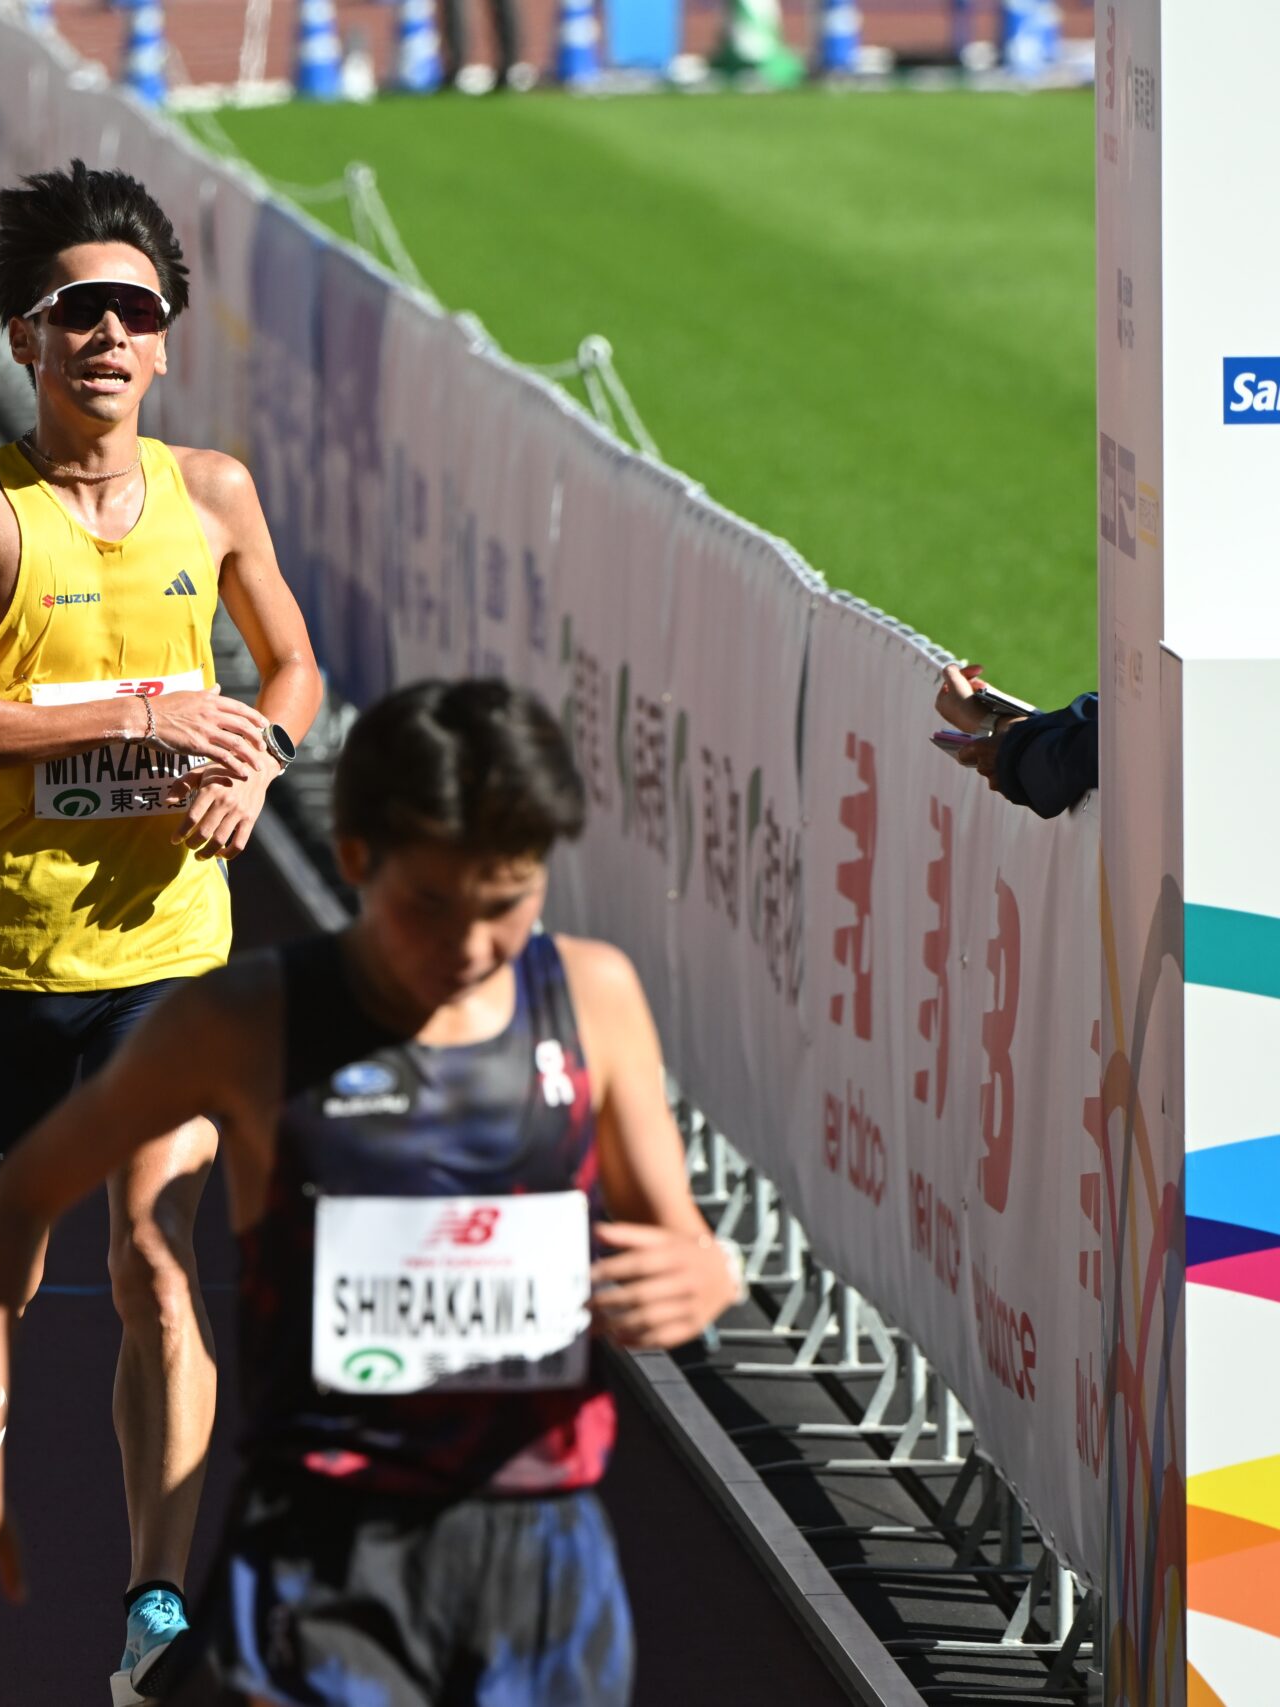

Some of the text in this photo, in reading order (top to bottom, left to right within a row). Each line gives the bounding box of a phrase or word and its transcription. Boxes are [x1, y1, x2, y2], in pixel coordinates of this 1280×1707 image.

[1230, 372, 1280, 412] Sa
[56, 593, 100, 605] SUZUKI
[332, 1275, 542, 1338] SHIRAKAWA
